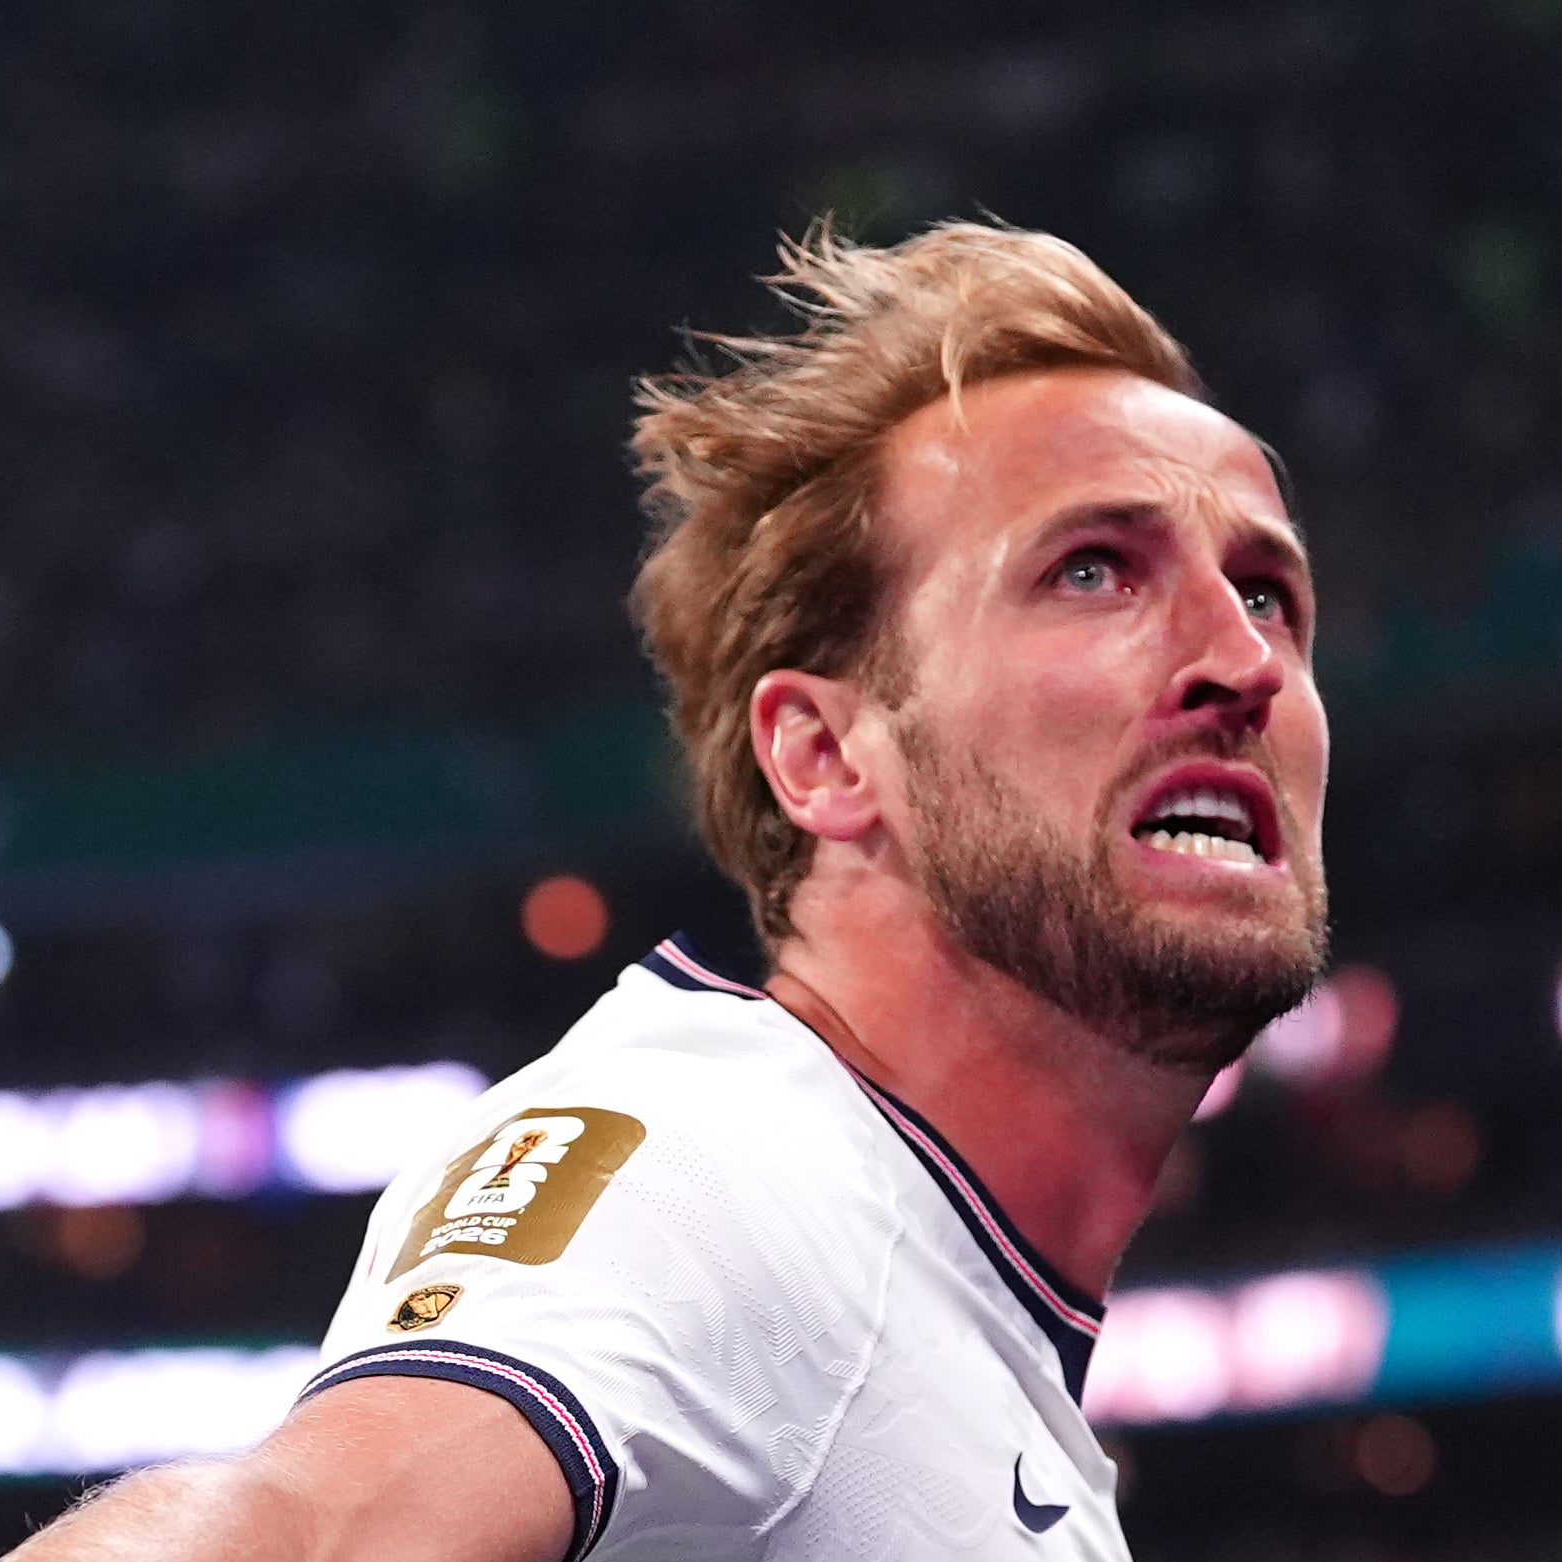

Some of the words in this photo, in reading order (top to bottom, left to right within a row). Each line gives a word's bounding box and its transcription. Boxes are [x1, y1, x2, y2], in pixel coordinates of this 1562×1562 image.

[467, 1193, 505, 1206] FIFA
[431, 1217, 481, 1238] WORLD
[482, 1217, 517, 1228] CUP
[419, 1227, 508, 1257] 2026
